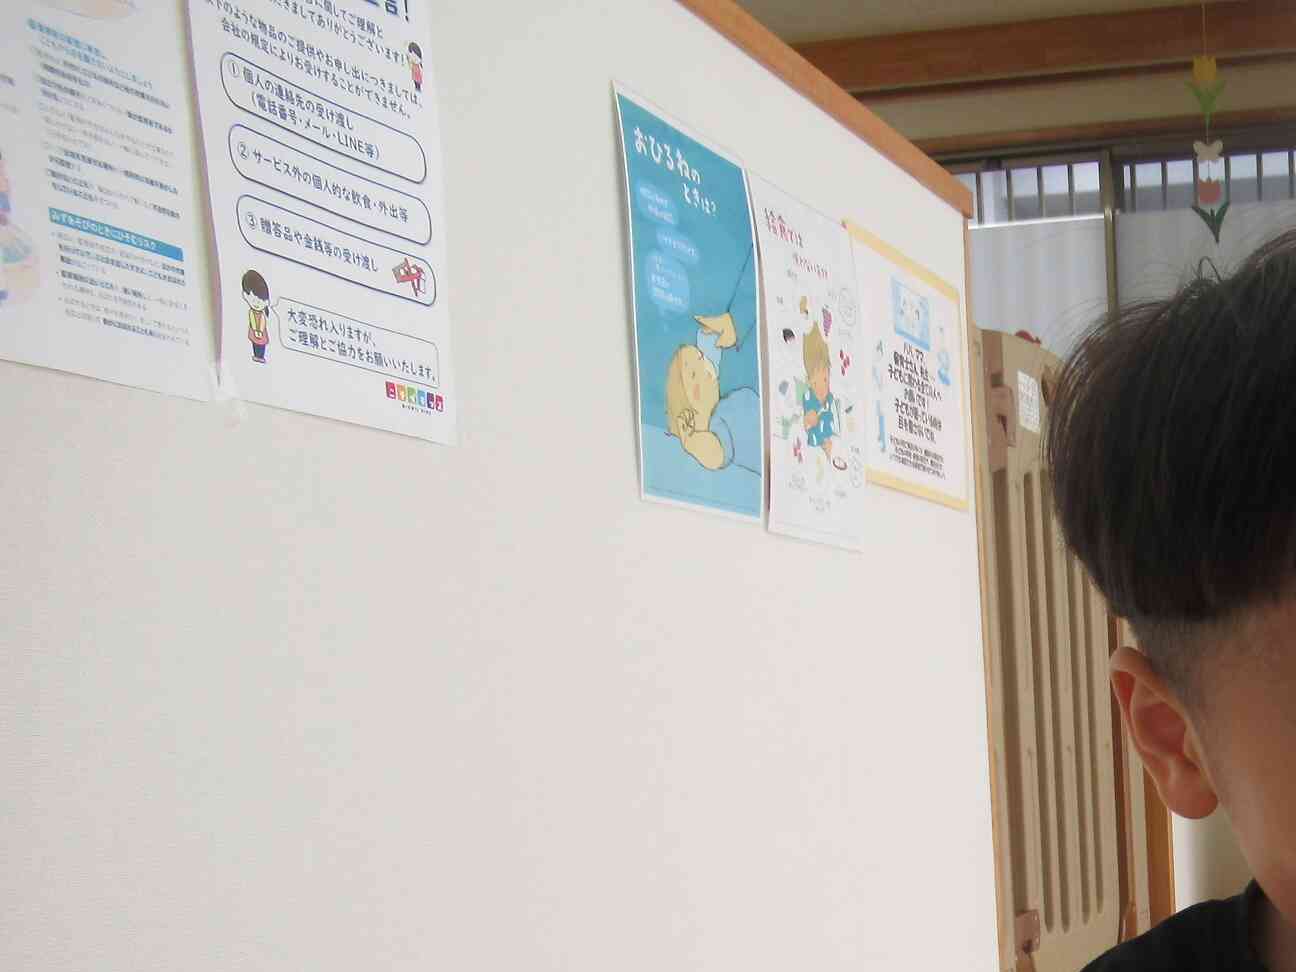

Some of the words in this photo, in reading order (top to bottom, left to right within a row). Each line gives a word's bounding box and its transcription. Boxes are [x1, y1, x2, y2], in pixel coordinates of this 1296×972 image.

[634, 125, 702, 184] おひるねの
